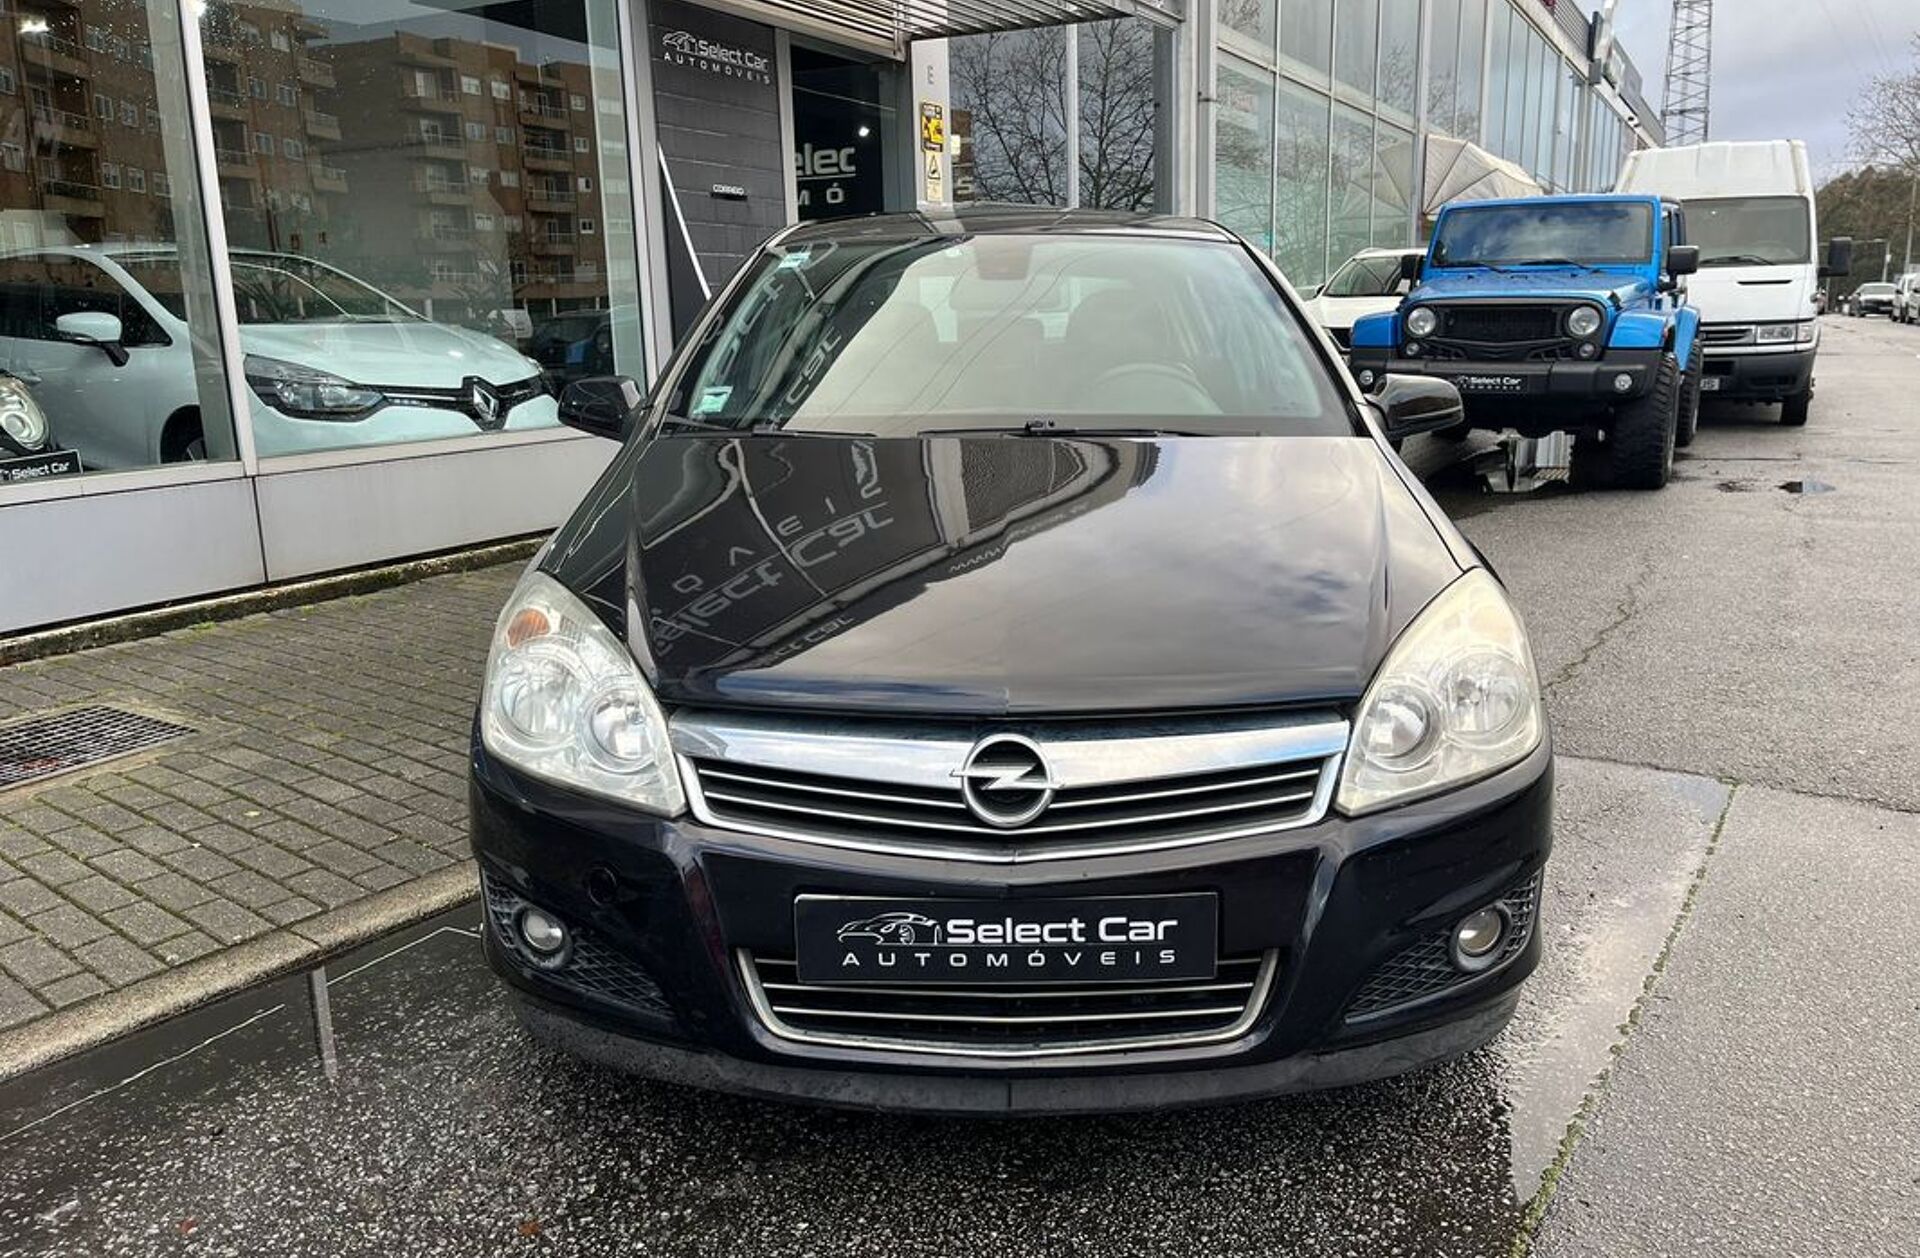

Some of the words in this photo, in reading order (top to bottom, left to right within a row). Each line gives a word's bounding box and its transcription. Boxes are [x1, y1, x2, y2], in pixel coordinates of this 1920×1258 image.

[946, 917, 1087, 944] Select
[1098, 916, 1179, 942] Car
[842, 949, 1176, 967] AUTOMÓVEIS
